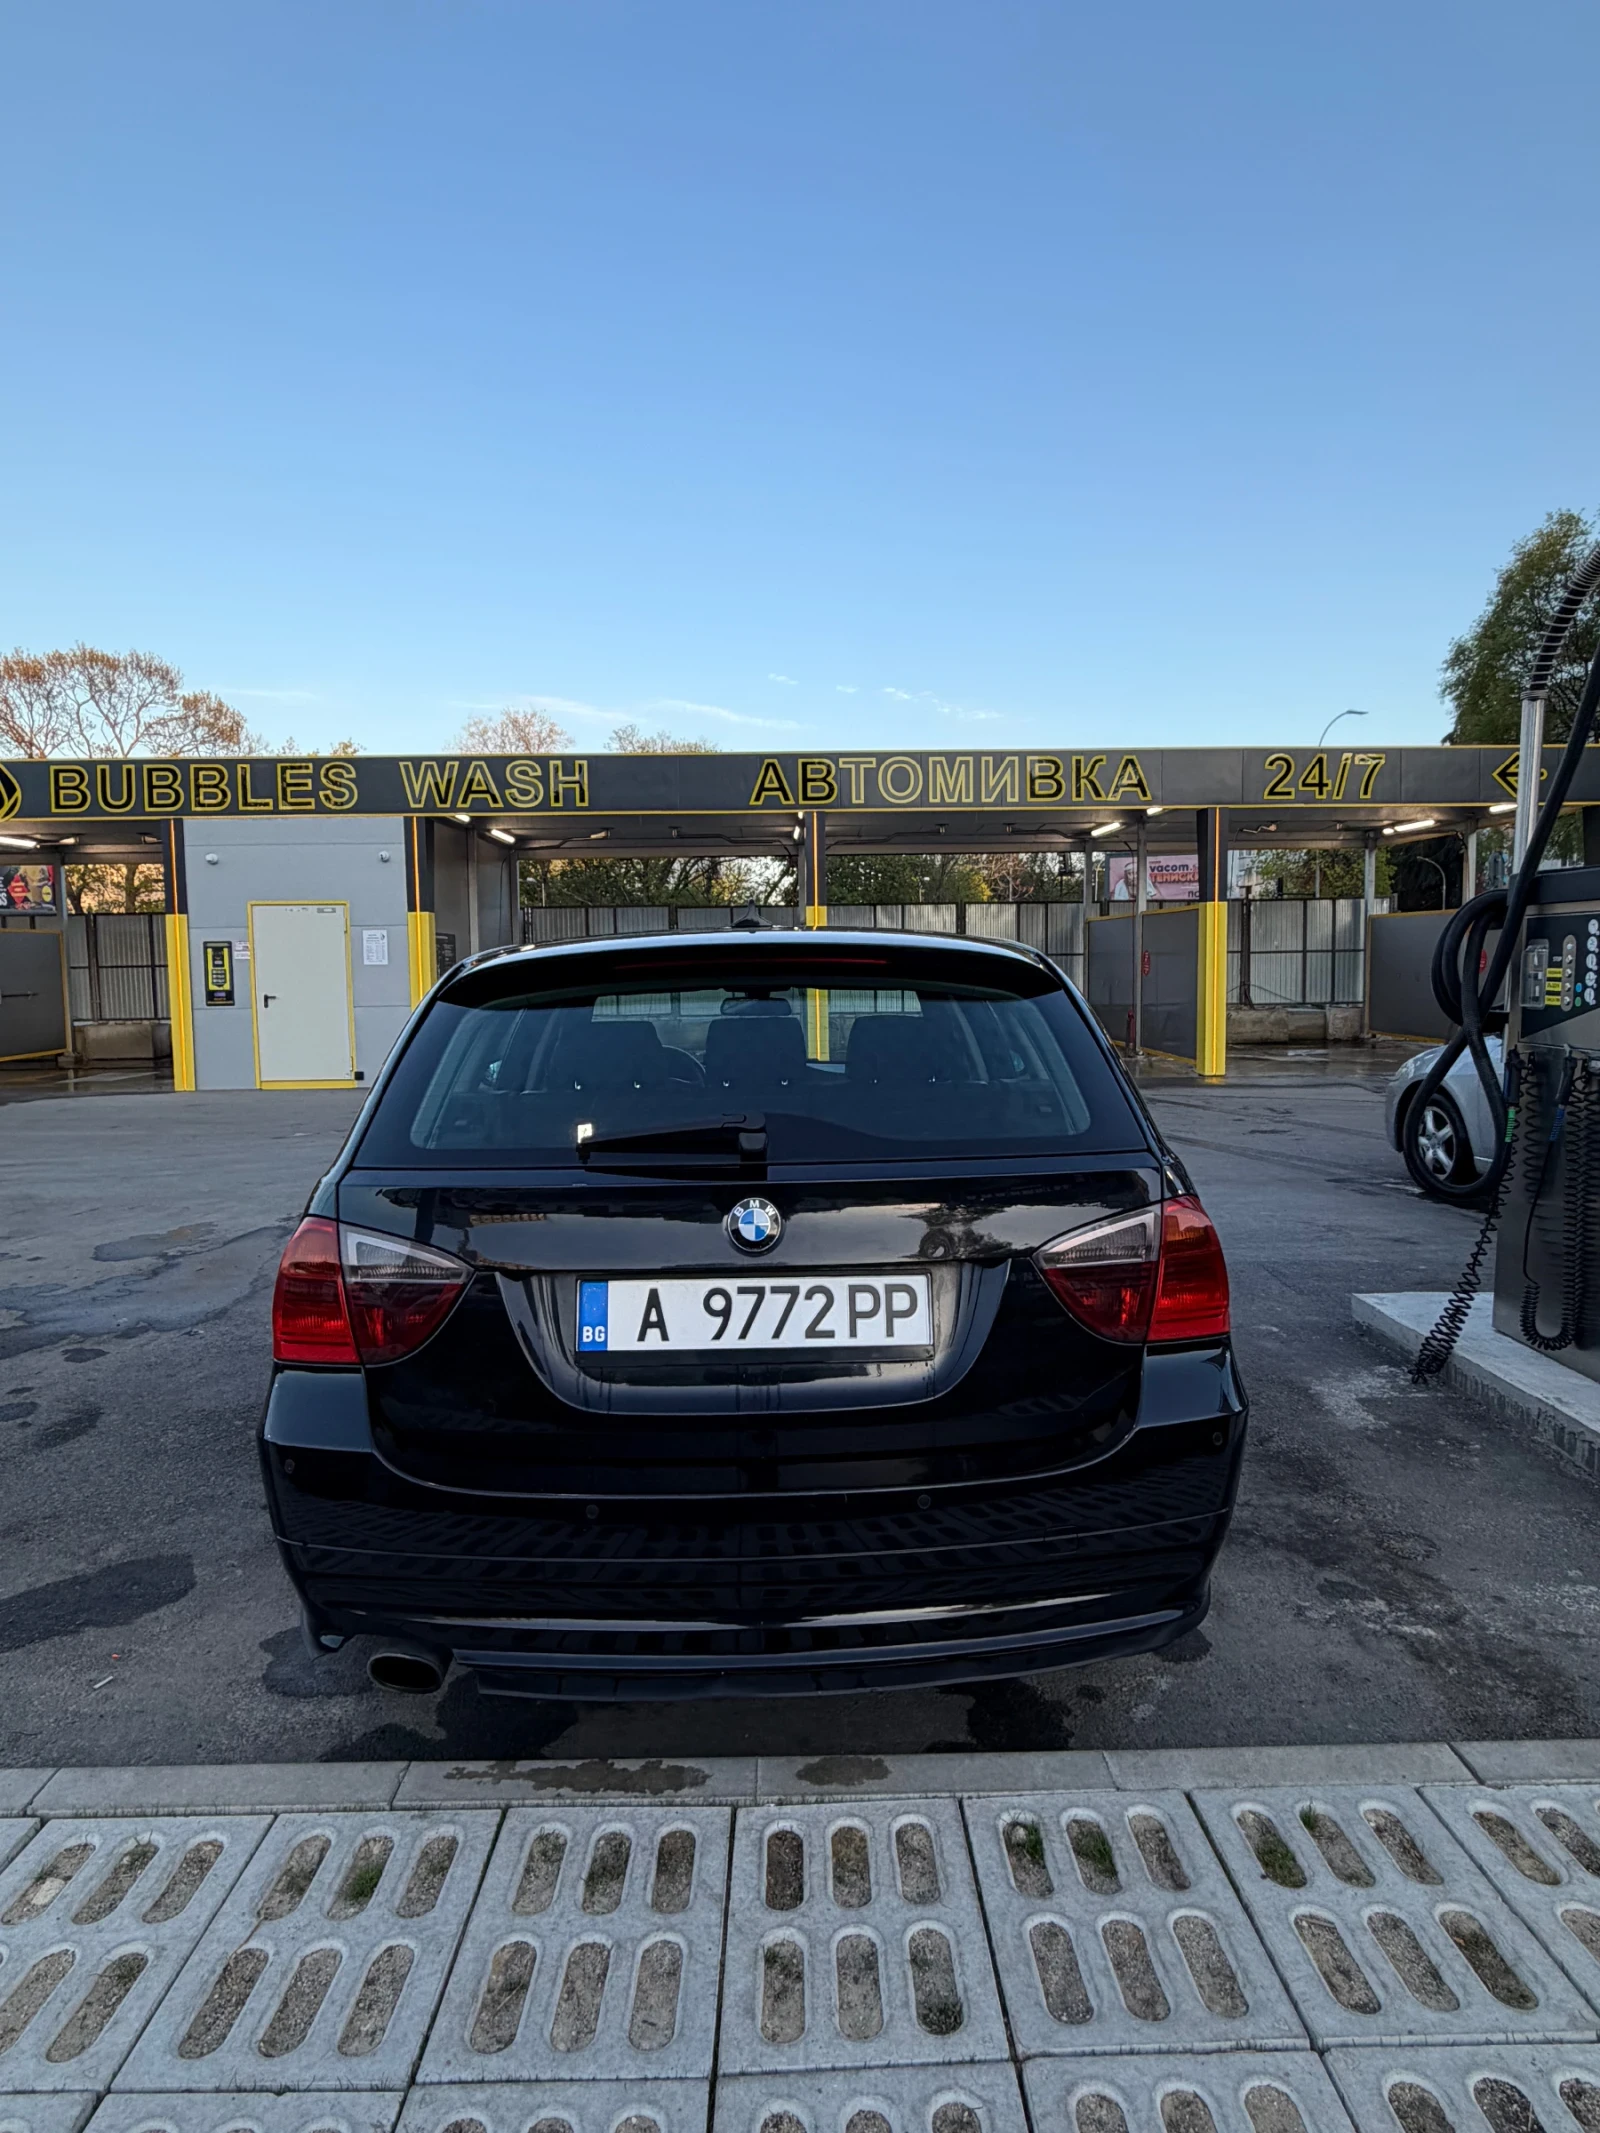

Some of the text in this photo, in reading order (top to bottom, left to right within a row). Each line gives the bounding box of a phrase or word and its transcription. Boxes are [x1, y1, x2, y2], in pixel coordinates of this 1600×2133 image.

[49, 759, 589, 813] BUBBLES WASH
[749, 754, 1153, 806] АВТОМИВКА
[1263, 752, 1386, 800] 24/7
[733, 1199, 776, 1217] BMW
[582, 1325, 606, 1343] BG
[637, 1288, 670, 1342] A
